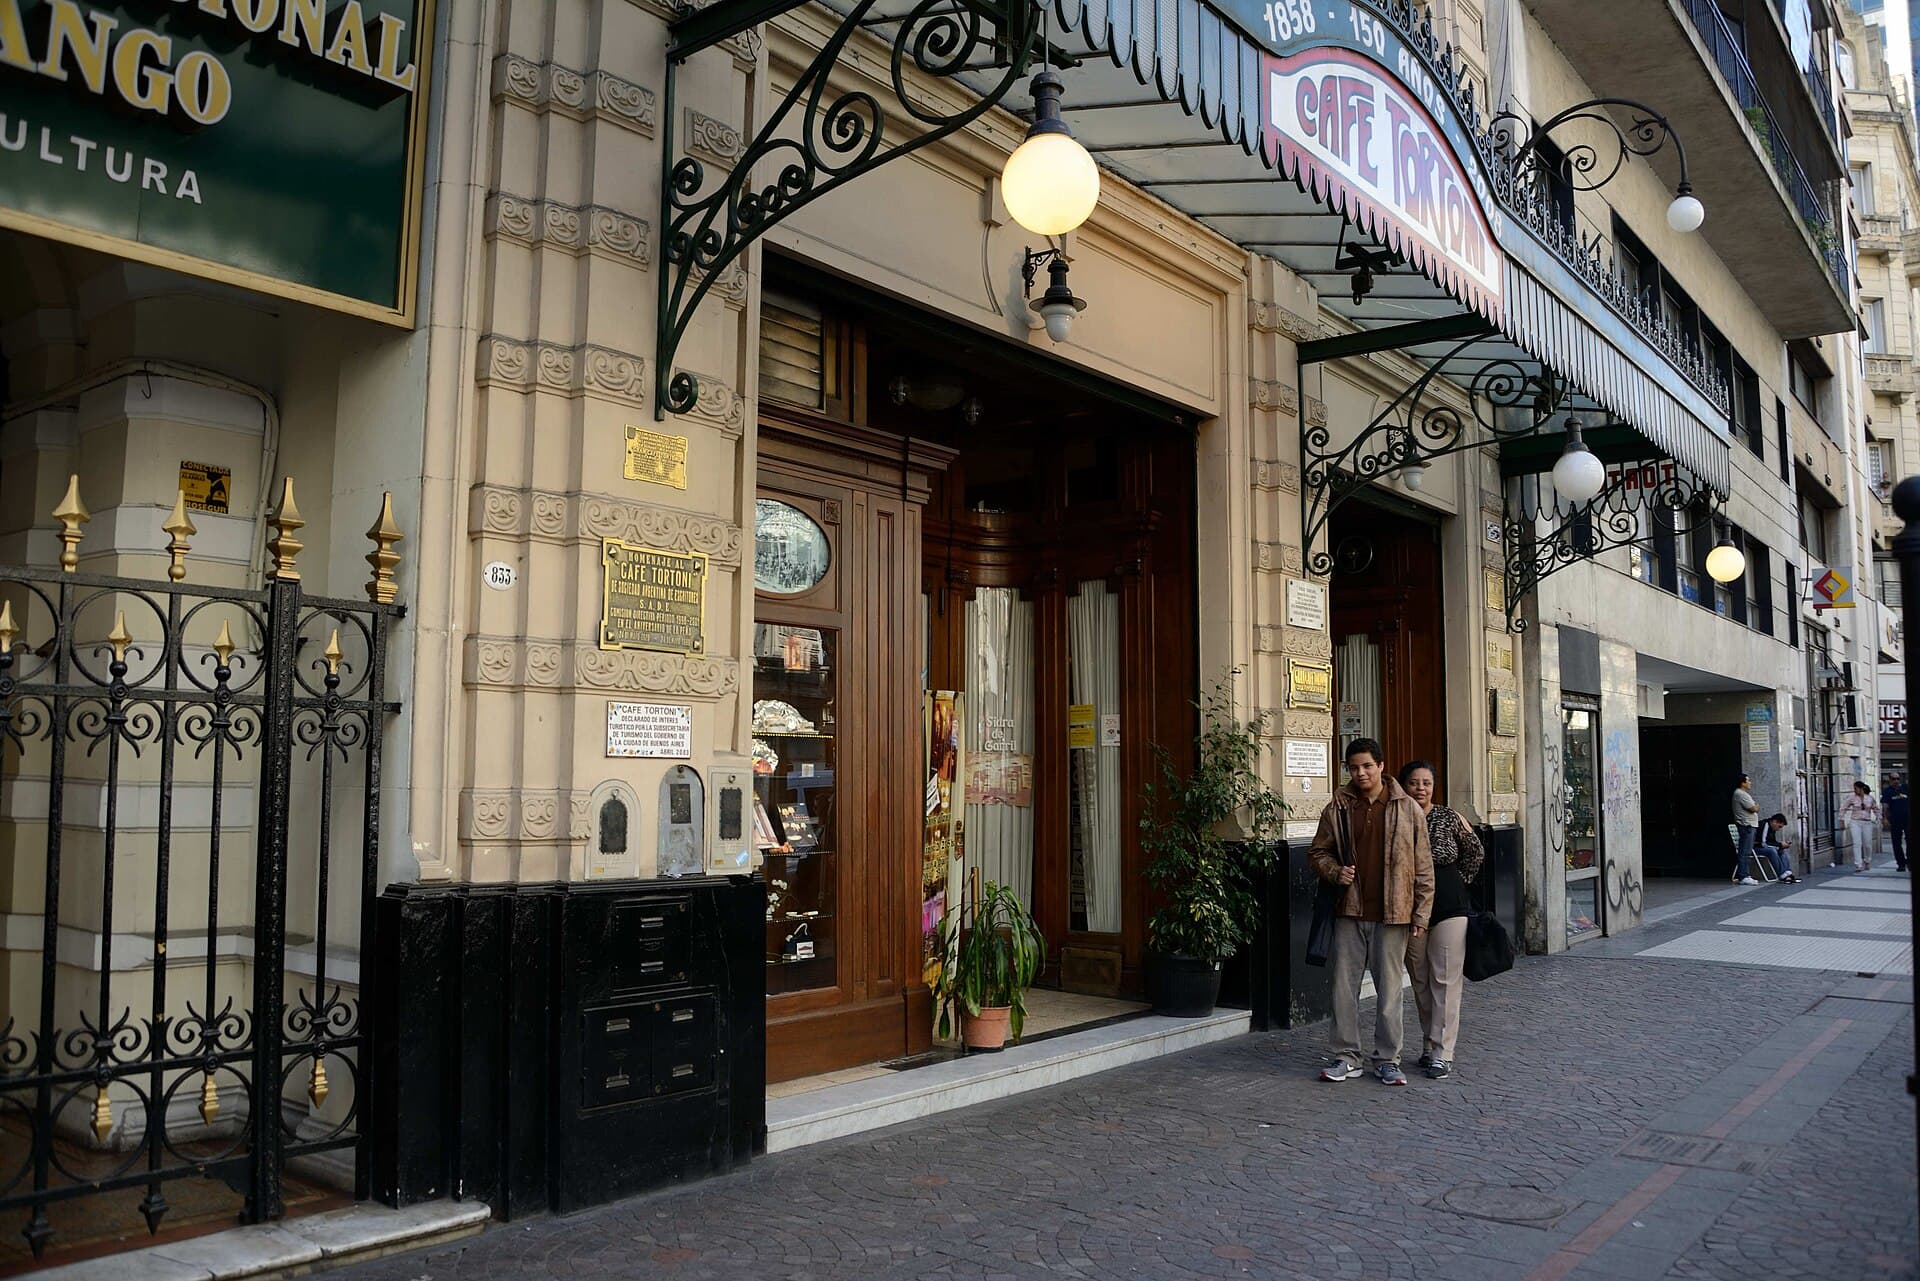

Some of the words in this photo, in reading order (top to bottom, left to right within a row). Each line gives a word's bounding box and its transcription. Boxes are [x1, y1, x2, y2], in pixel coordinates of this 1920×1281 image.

[1264, 1, 1316, 42] 1858
[1350, 9, 1386, 57] 150
[1468, 154, 1502, 239] 2008
[0, 113, 202, 204] ULTURA
[1296, 75, 1379, 188] CAFE
[1385, 92, 1487, 278] TORTONI
[185, 500, 227, 514] ROSEGUR
[628, 551, 671, 568] HOMENAJE
[675, 559, 684, 570] AL
[491, 566, 511, 585] 833
[621, 715, 650, 723] DECLARADO
[644, 706, 676, 715] TORTONI
[1877, 704, 1907, 719] TIEN
